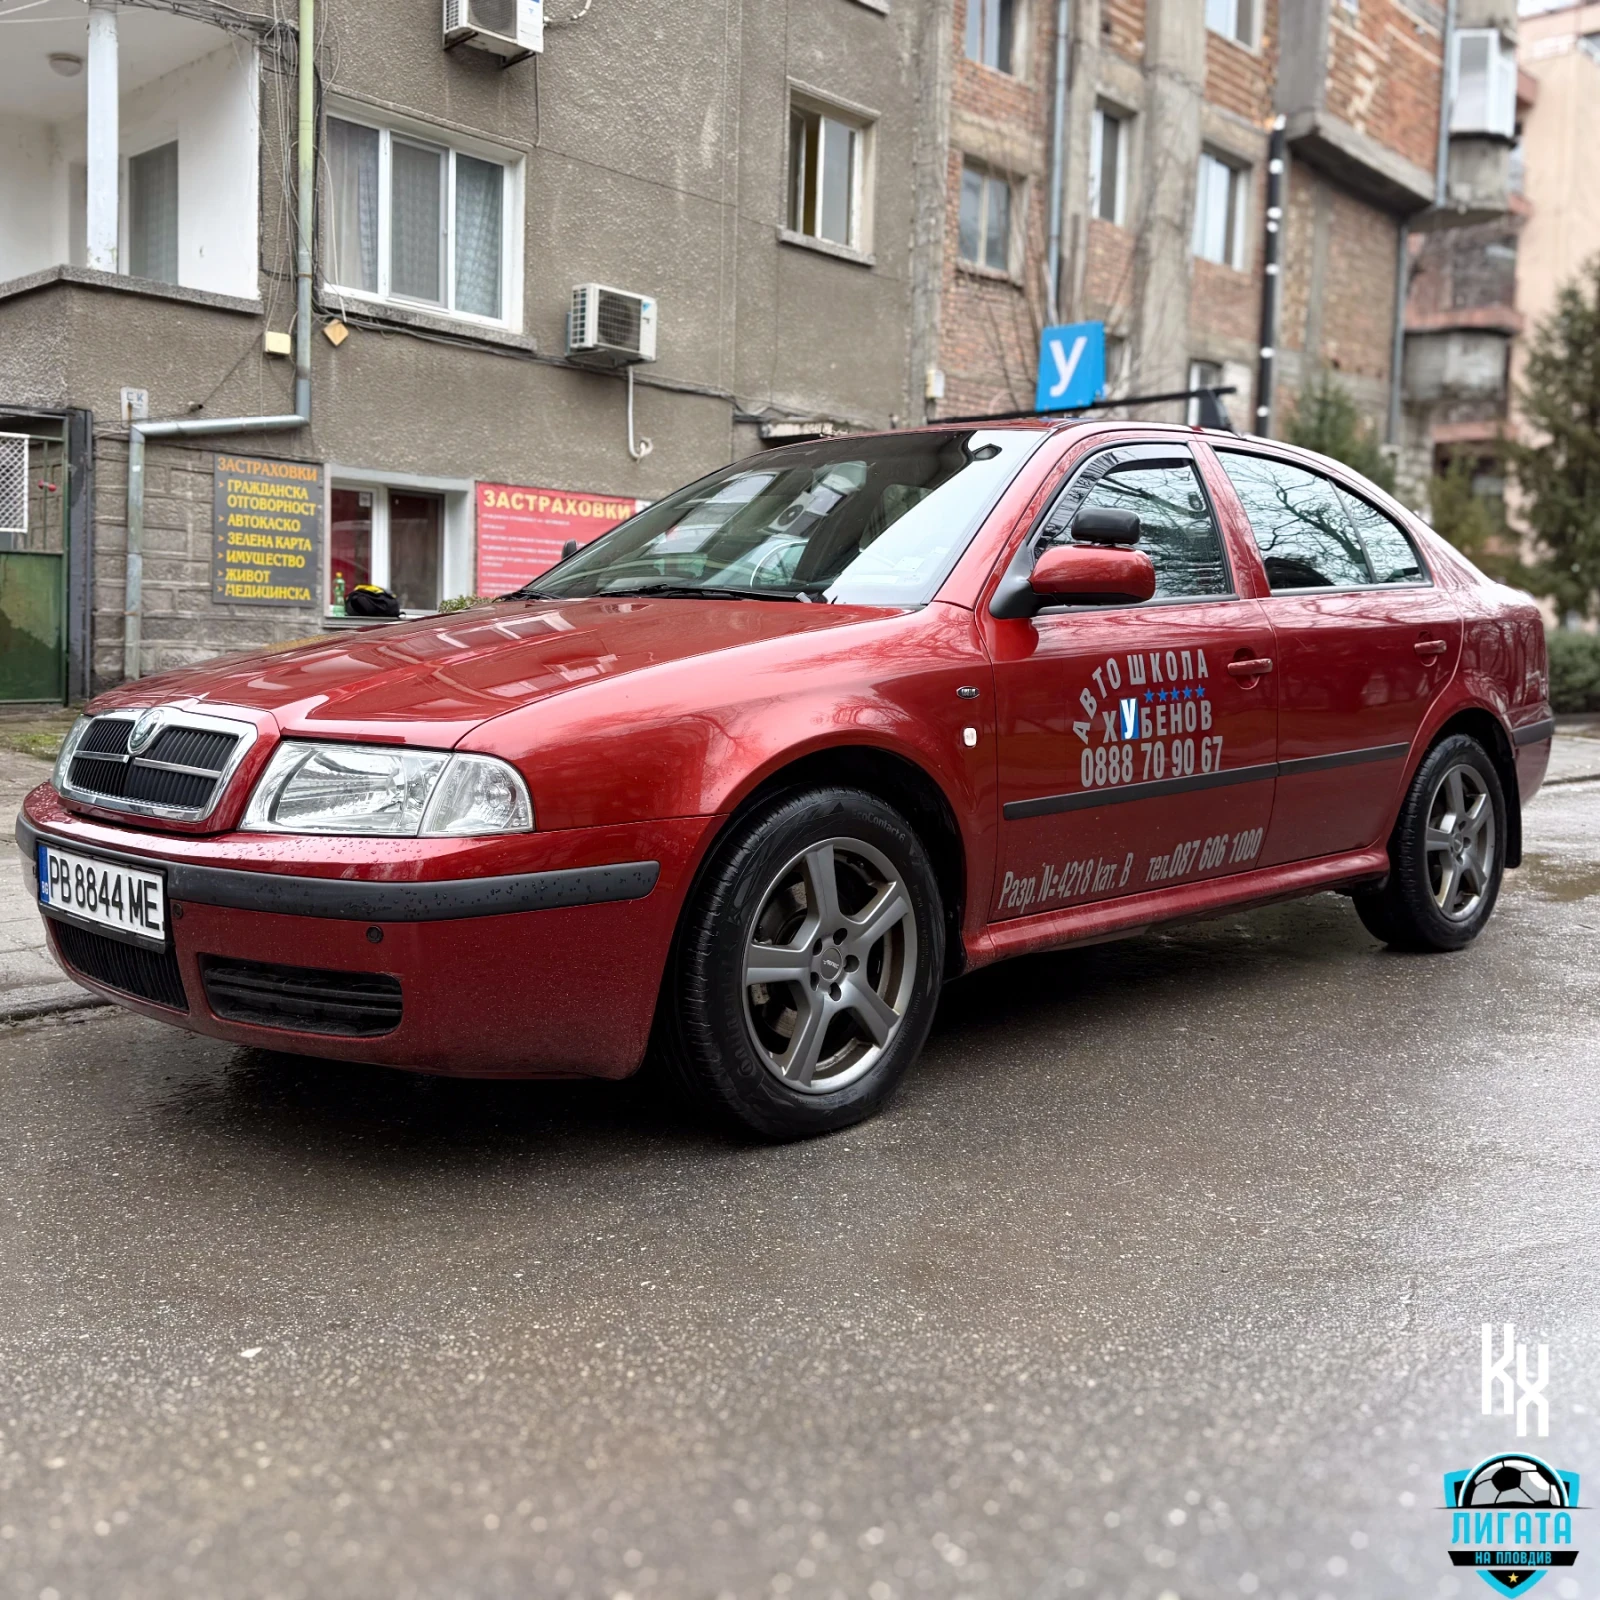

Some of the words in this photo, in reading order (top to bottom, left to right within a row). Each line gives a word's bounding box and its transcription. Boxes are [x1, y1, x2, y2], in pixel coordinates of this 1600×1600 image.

[1049, 335, 1088, 398] У
[217, 456, 318, 482] ЗАСТРАХОВКИ
[227, 479, 309, 500] ГРАЖДАНСКА
[227, 494, 317, 516] ОТГОВОРНОСТ
[483, 489, 631, 520] ЗАСТРАХОВКИ
[227, 513, 302, 533] АВТОКАСКО
[227, 532, 273, 549] ЗЕЛЕНА
[275, 535, 312, 552] КАРТА
[226, 550, 306, 568] ИМУЩЕСТВО
[225, 568, 271, 583] ЖИВОТ
[1072, 657, 1122, 745] АВТО
[1127, 648, 1209, 686] ШКОЛА
[1102, 698, 1213, 744] ХУБЕНОВ
[1081, 744, 1134, 788] 0888
[1141, 741, 1165, 780] 70
[1171, 738, 1195, 777] 90
[1200, 735, 1224, 773] 67
[998, 871, 1036, 914] Разр.
[1198, 834, 1228, 871] 606
[1228, 827, 1264, 864] 1000
[75, 863, 124, 921] 8844
